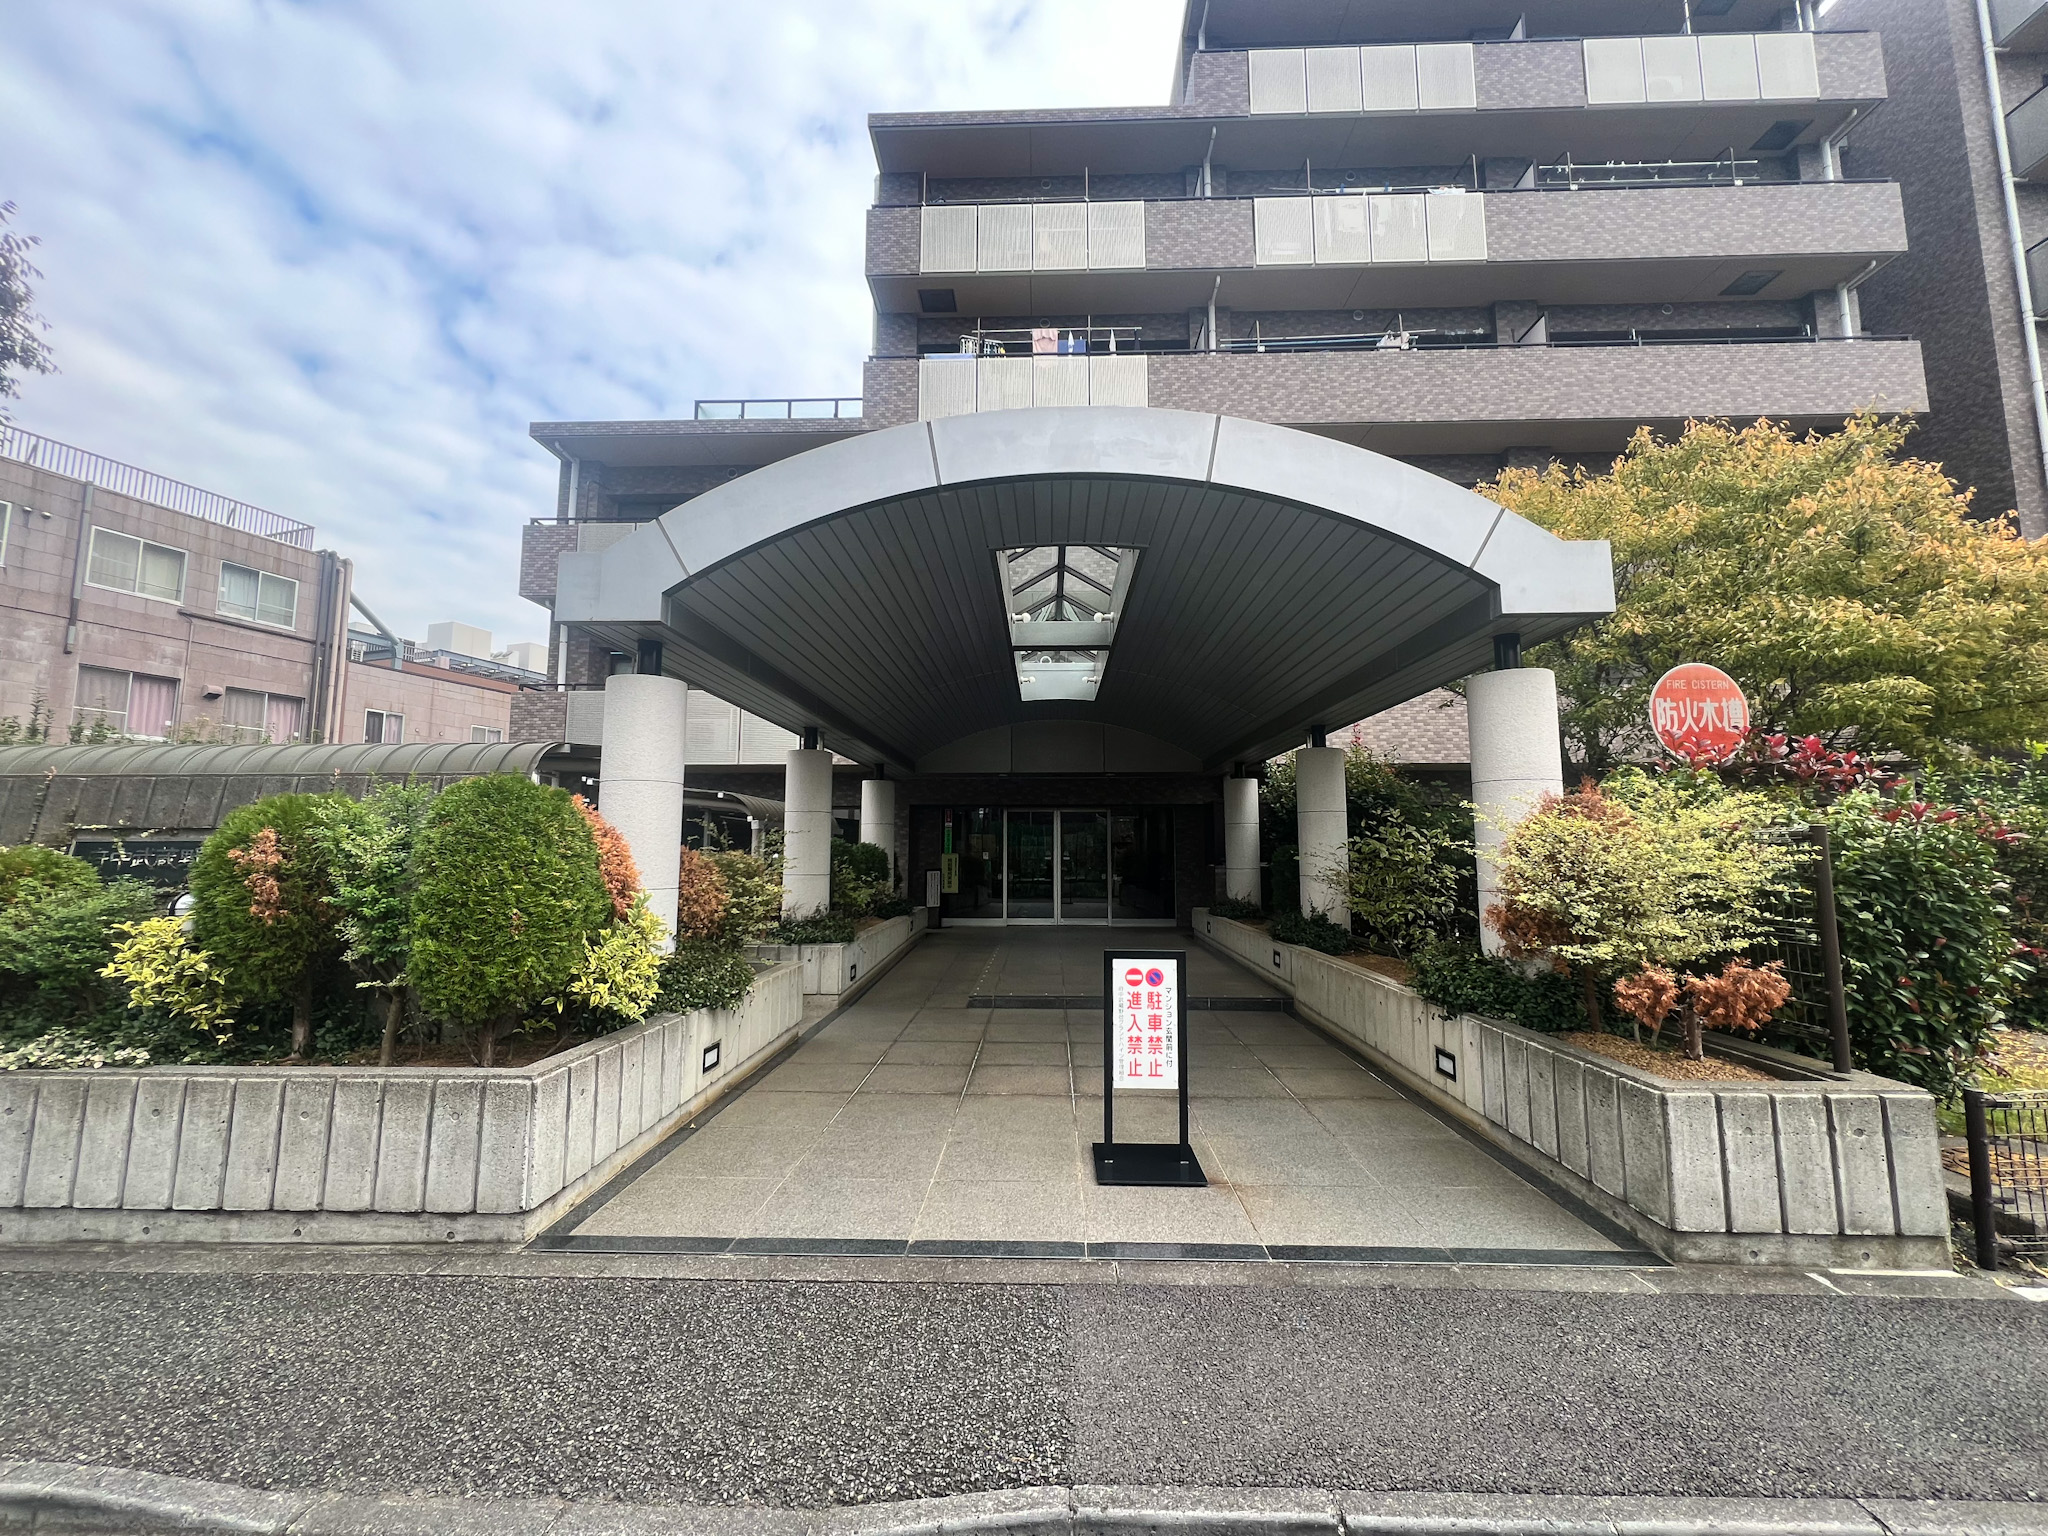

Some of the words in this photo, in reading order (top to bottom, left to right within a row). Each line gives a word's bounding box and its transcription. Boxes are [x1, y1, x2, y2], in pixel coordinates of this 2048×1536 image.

[1666, 679, 1687, 690] FIRE
[1691, 679, 1729, 690] CISTERN
[1126, 991, 1143, 1077] 進入禁止
[1146, 991, 1163, 1077] 駐車禁止
[1165, 987, 1173, 1068] マンション玄関前に付
